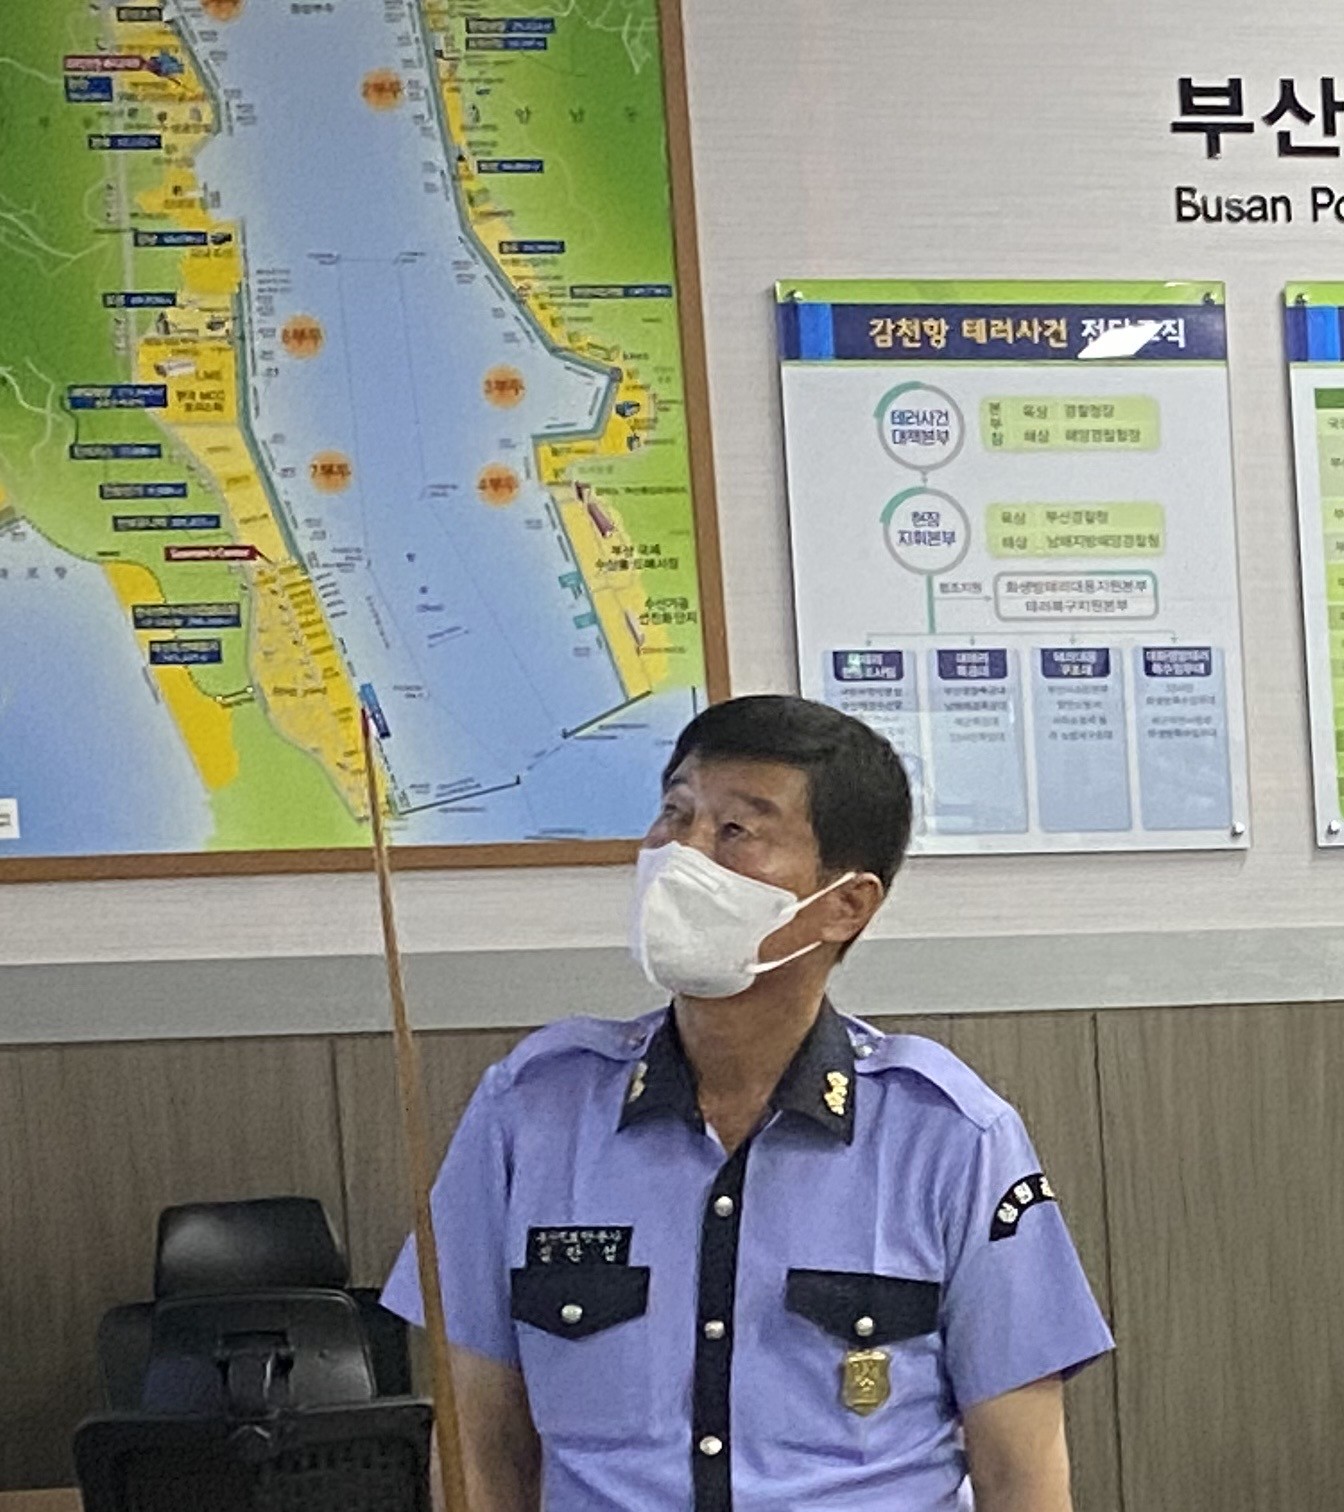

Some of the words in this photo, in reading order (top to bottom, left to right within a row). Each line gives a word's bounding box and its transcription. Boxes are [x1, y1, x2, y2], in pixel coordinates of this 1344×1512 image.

[1174, 185, 1292, 224] Busan
[868, 317, 949, 349] 감천항
[961, 317, 1068, 348] 테러사건
[1081, 317, 1186, 348] 전직
[891, 409, 949, 426] 테러사건
